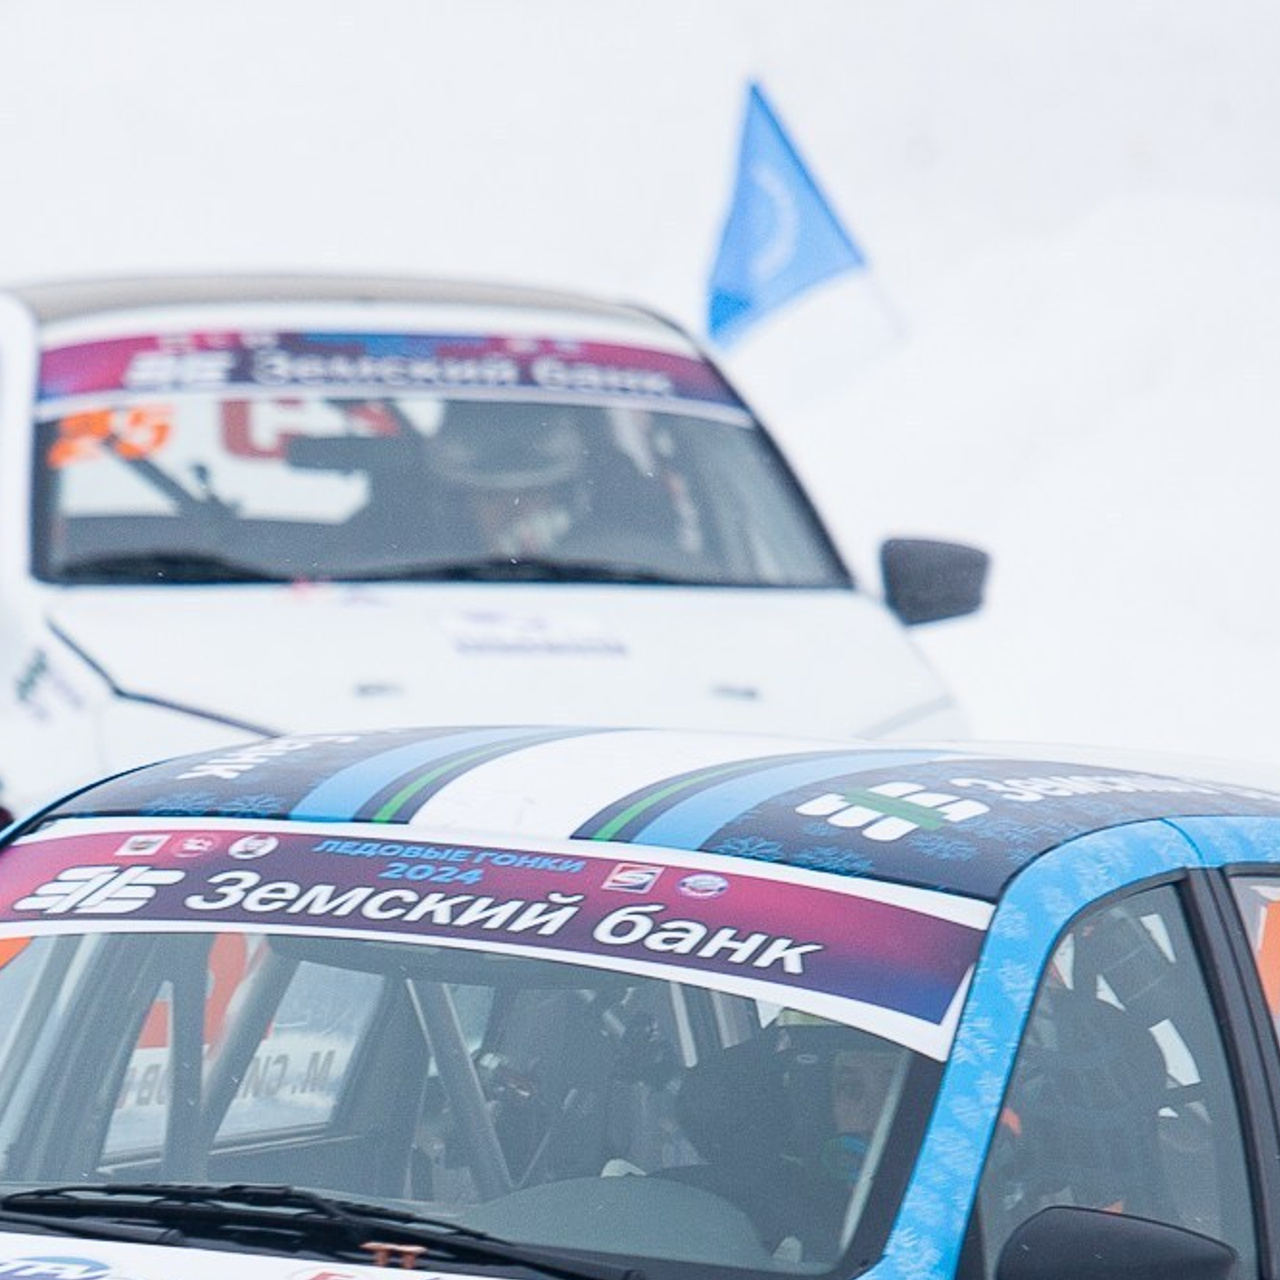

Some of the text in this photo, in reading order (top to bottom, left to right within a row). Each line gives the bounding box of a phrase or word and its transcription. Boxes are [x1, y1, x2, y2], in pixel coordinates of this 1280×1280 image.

[312, 839, 587, 875] ЛЕДОВЫЕ ГОНКИ
[377, 862, 487, 886] 2024
[183, 869, 824, 975] Земский банк
